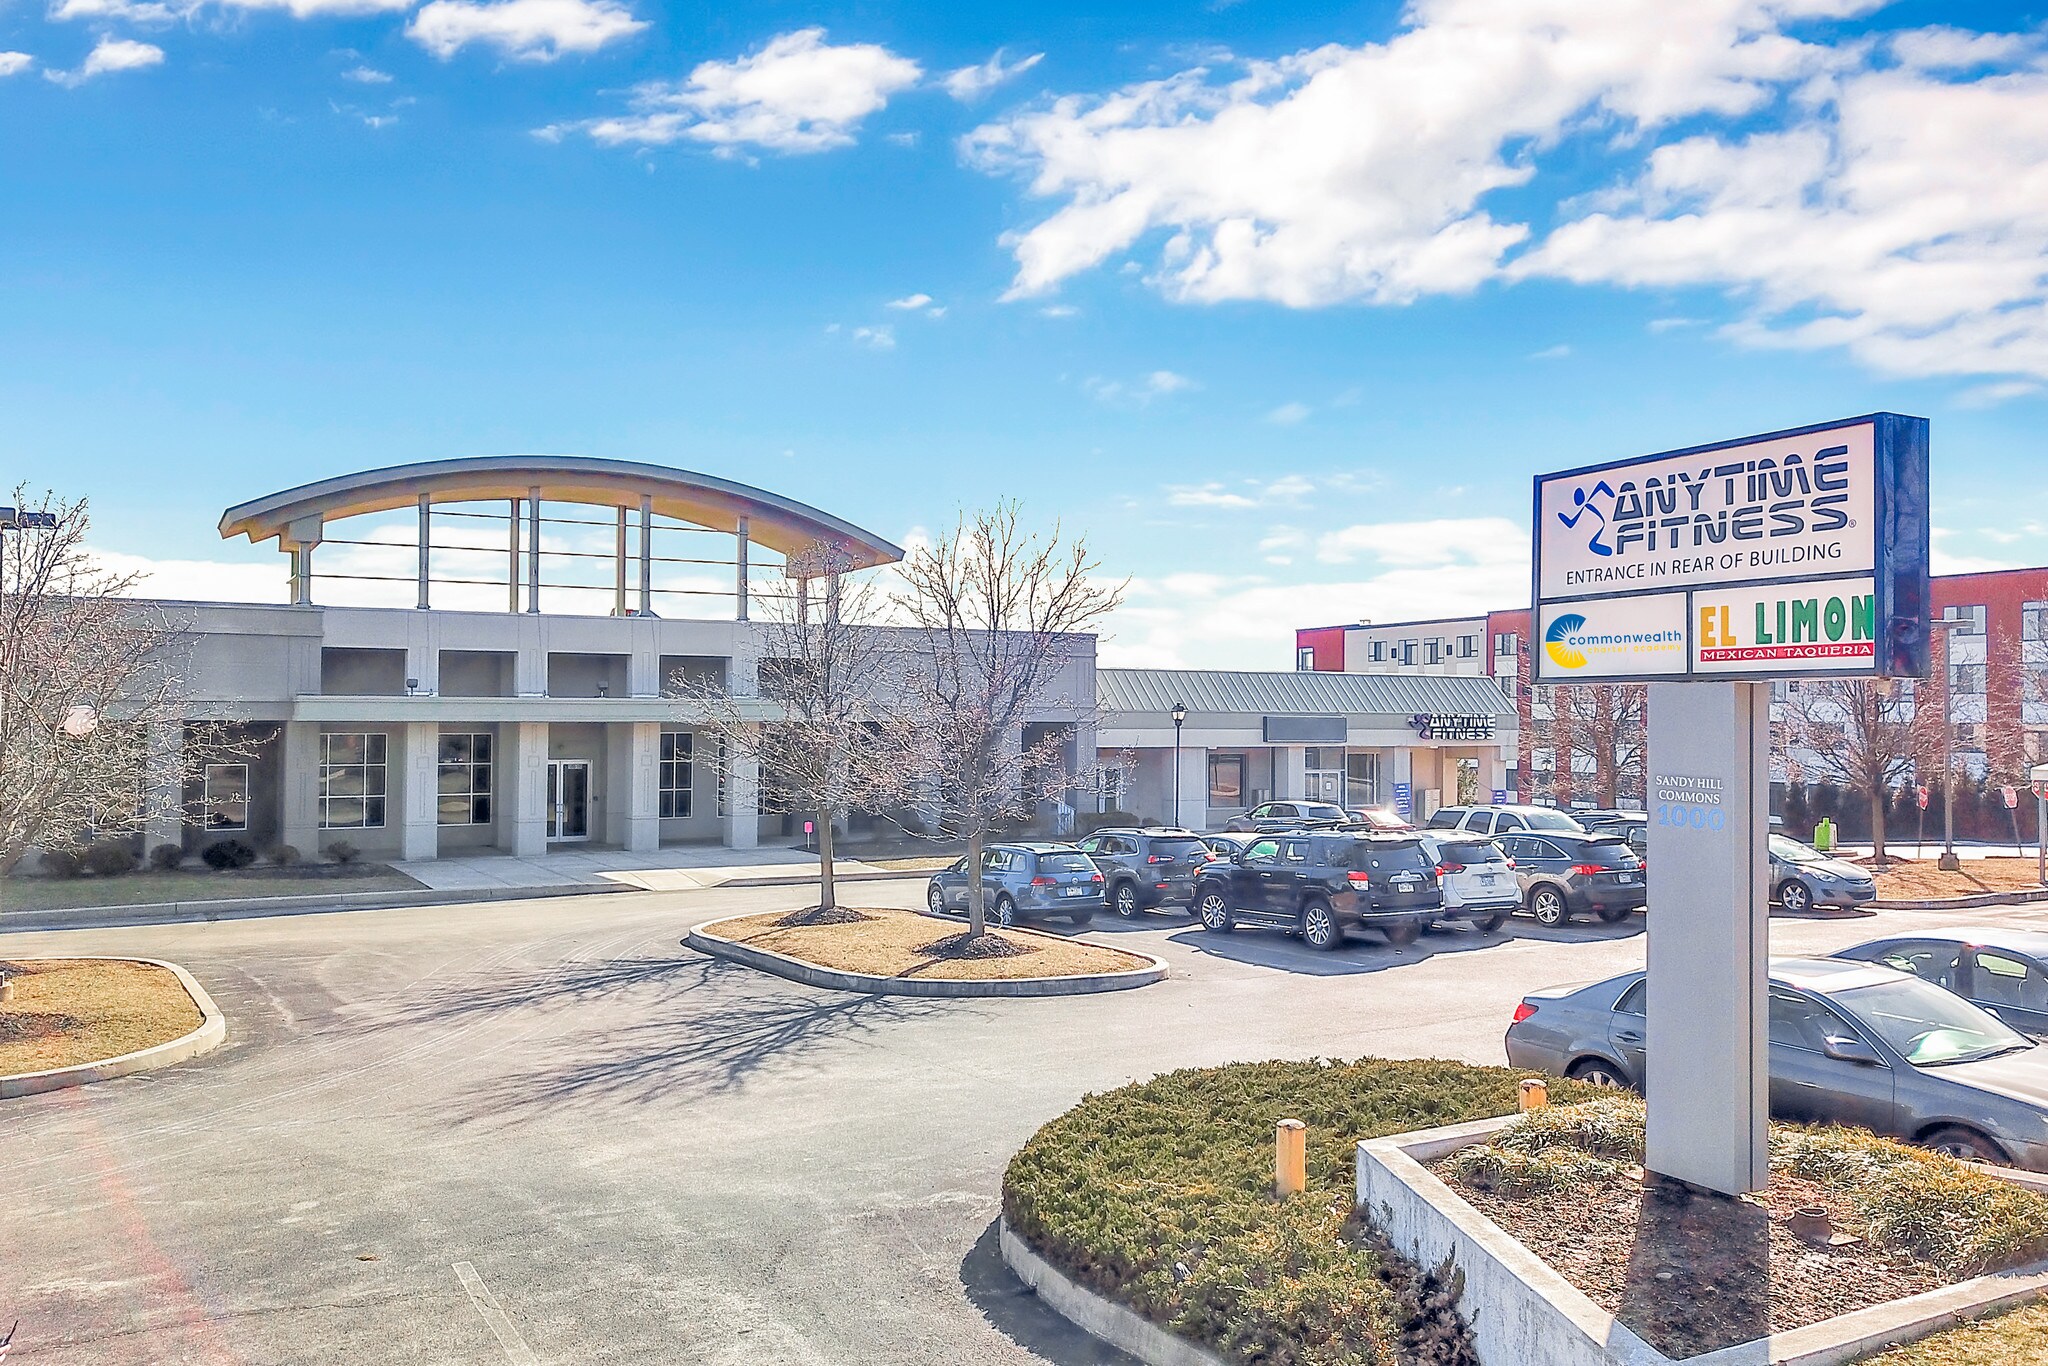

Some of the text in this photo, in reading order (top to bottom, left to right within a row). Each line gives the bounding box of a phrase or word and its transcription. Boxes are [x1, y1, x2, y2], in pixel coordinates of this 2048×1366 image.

[1612, 445, 1848, 522] ANYTIME
[1616, 494, 1849, 555] FITNESS
[1566, 542, 1842, 585] ENTRANCE IN REAR OF BUILDING
[1700, 594, 1875, 647] EL LIMON
[1568, 629, 1682, 646] commonwealth
[1587, 643, 1682, 654] charter academy
[1703, 645, 1872, 660] MEXICAN TAQUERIA
[1429, 713, 1496, 727] ANYTIME
[1432, 728, 1496, 740] FITNESS
[1655, 775, 1724, 790] SANDY HILL
[1658, 790, 1720, 804] COMMONS
[1657, 804, 1726, 832] 1000
